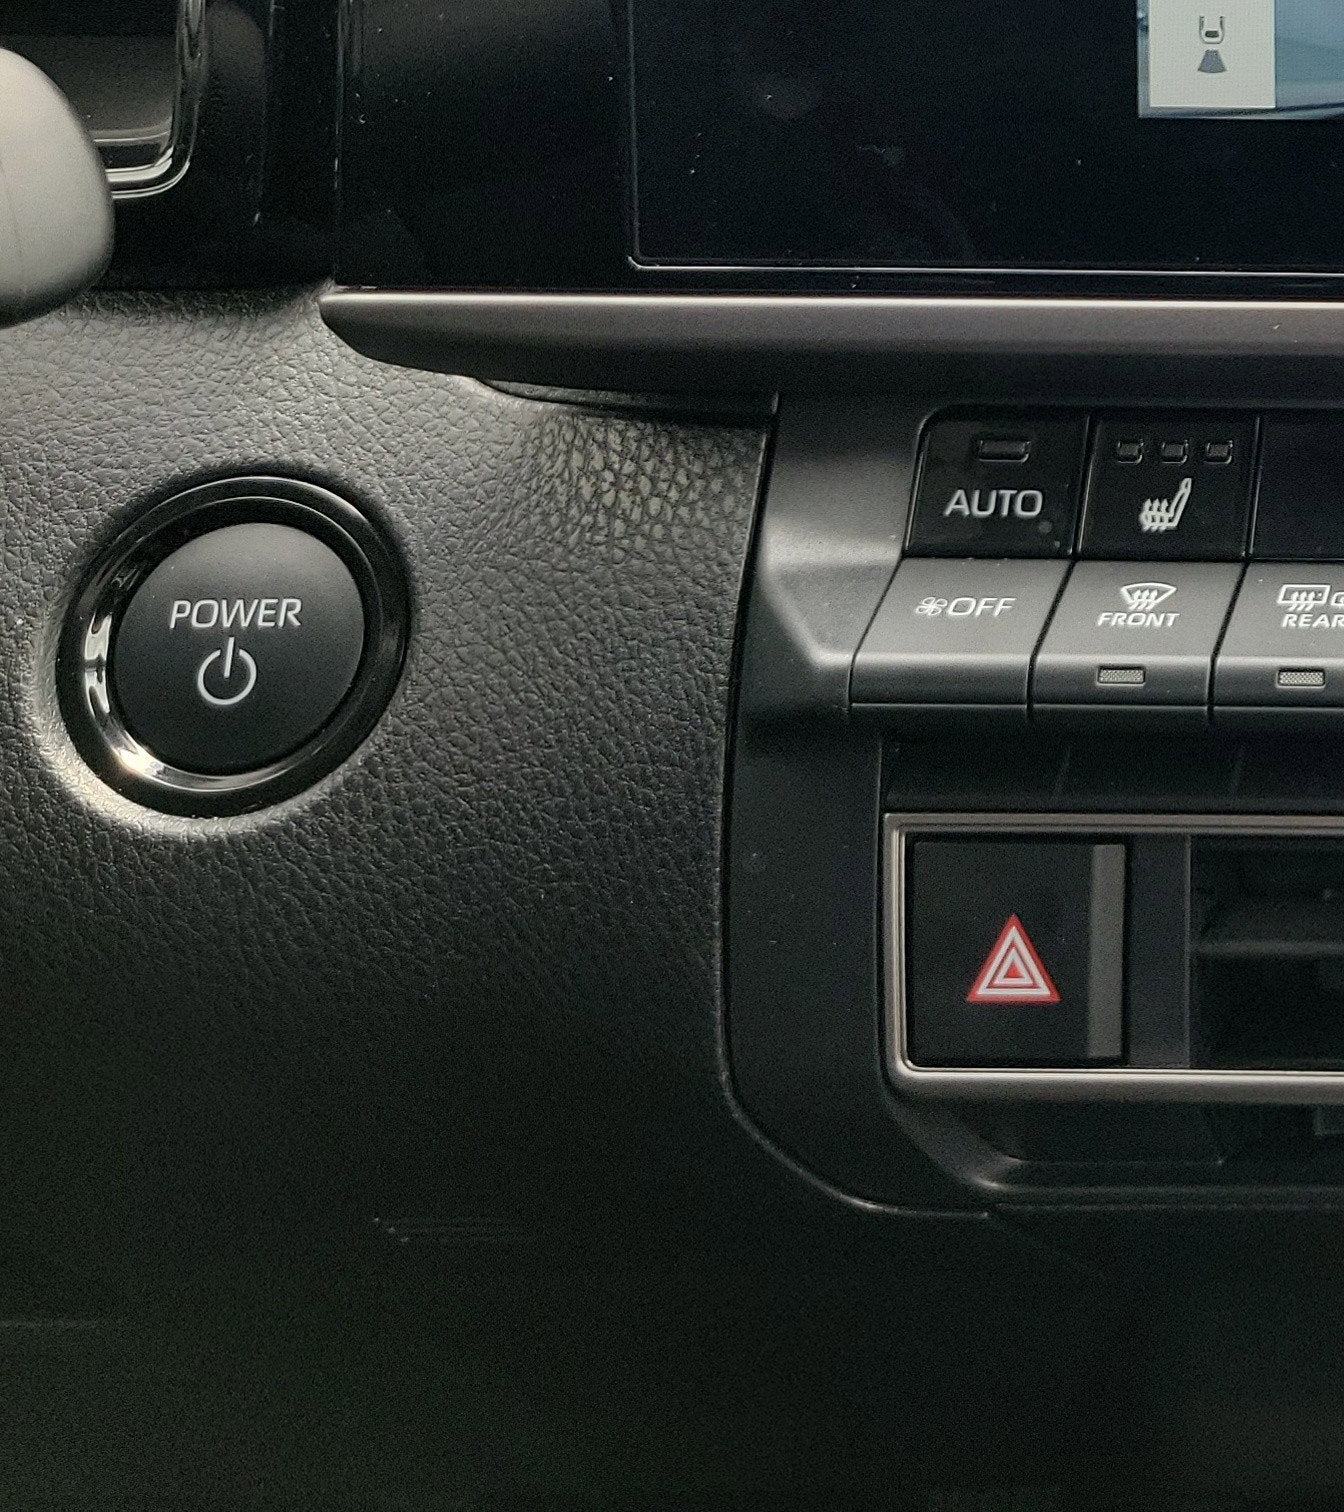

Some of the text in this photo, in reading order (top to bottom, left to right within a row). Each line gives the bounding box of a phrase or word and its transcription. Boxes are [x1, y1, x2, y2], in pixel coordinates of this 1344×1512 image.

[943, 489, 1043, 517] AUTO
[169, 598, 302, 629] POWER
[947, 597, 1016, 618] OFF
[1098, 612, 1180, 629] FRONT
